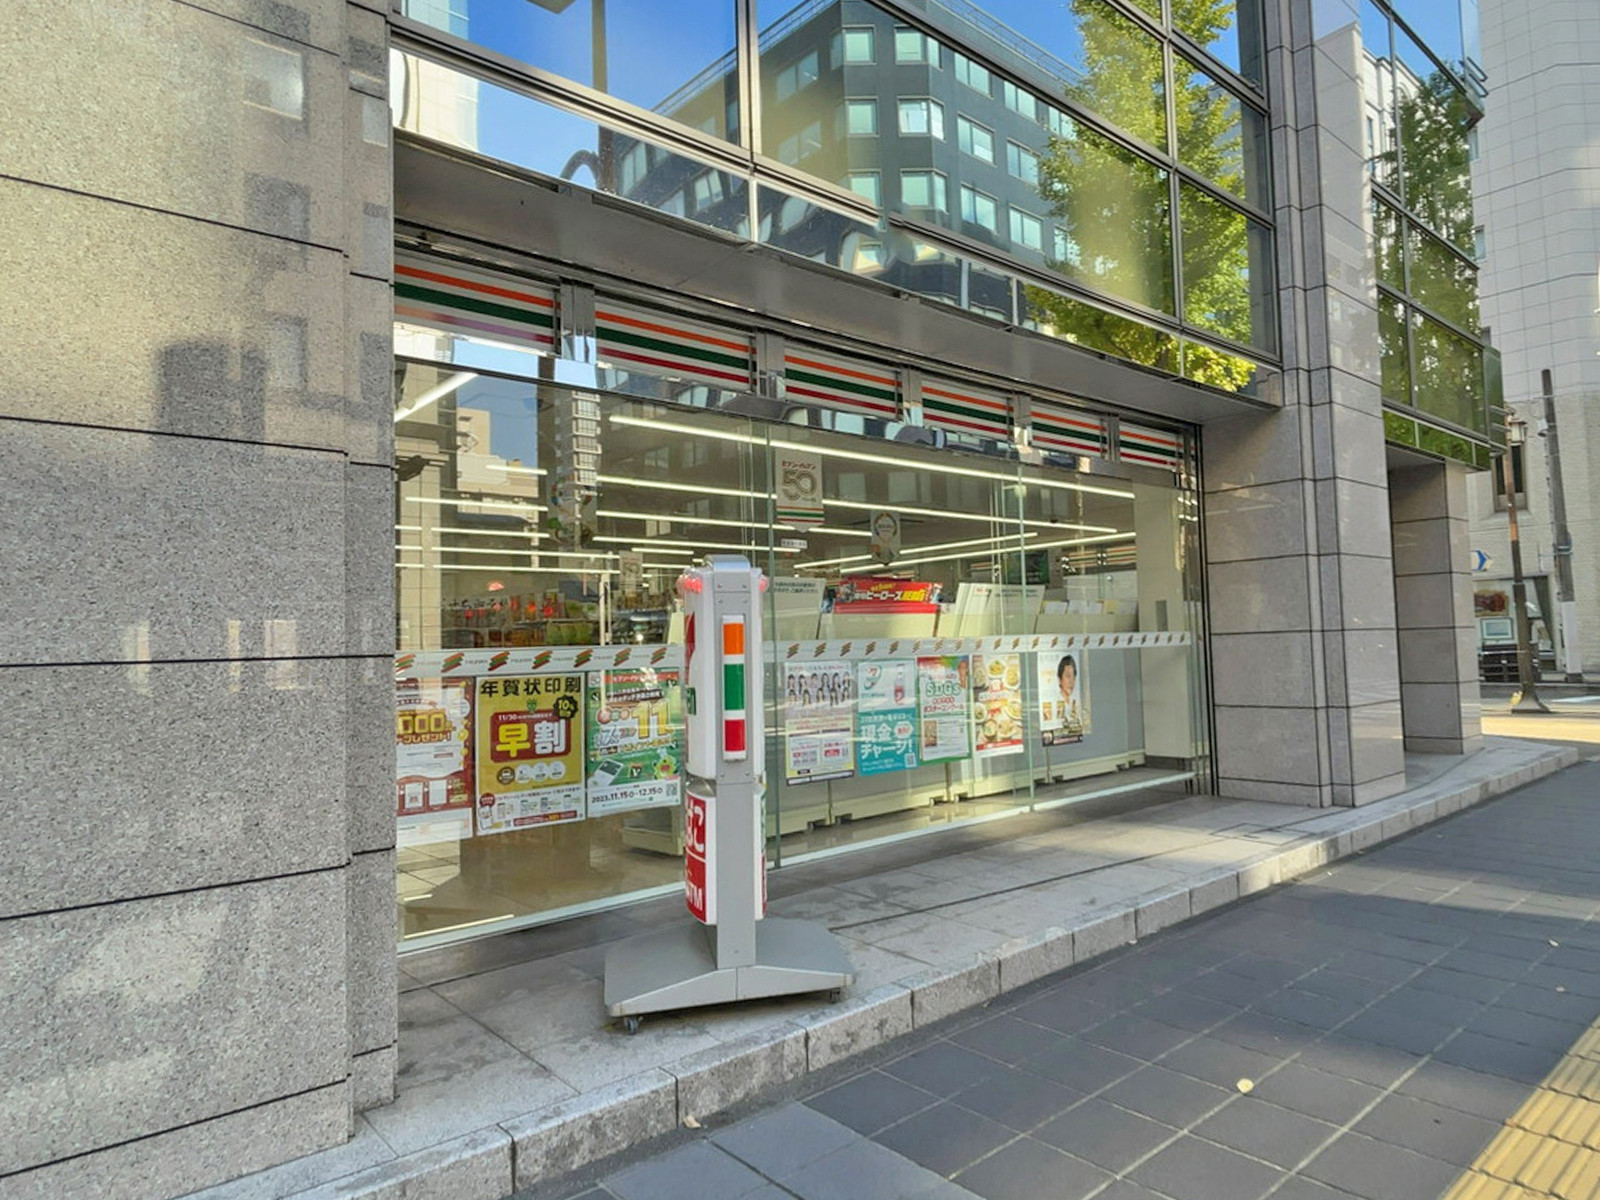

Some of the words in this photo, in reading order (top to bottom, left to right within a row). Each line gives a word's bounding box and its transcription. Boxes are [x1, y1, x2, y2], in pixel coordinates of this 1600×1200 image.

[782, 470, 817, 501] 50
[480, 676, 581, 698] 年賀状印刷
[925, 680, 961, 697] SDGs
[495, 719, 566, 758] 早割
[860, 722, 892, 742] 現金
[860, 739, 913, 760] チャージ!
